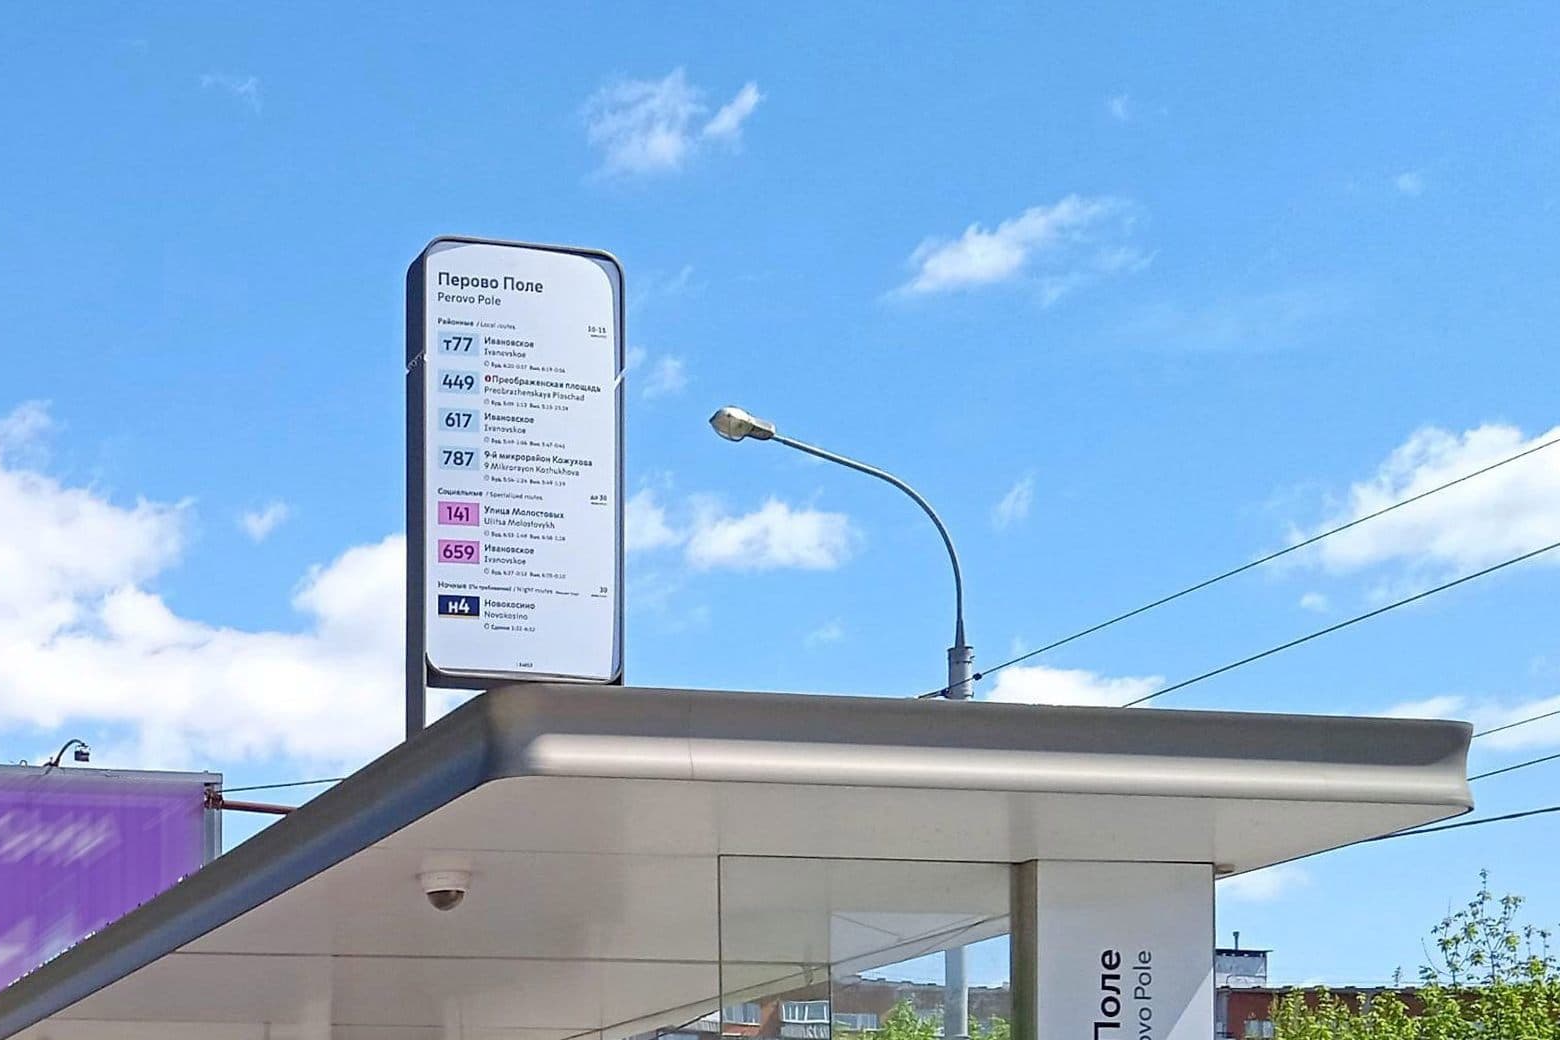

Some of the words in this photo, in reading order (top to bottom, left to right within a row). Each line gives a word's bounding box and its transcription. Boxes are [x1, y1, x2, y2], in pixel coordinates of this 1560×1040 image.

[438, 272, 499, 290] Перово
[503, 276, 544, 293] Поле
[438, 292, 475, 304] Perovo
[478, 294, 502, 306] Pole
[484, 336, 534, 348] Ивановское
[484, 348, 526, 358] Ivanovskoe
[442, 374, 474, 390] 449
[492, 375, 564, 389] Преображенская
[565, 382, 601, 393] площадь
[445, 412, 472, 428] 617
[484, 412, 535, 424] Ивановское
[484, 424, 526, 434] Ivanovskoe
[443, 450, 474, 467] 787
[499, 452, 551, 463] микрорайон
[552, 456, 593, 467] Кожухова
[447, 506, 470, 522] 141
[484, 505, 510, 515] Улица
[512, 507, 565, 518] Молостовых
[484, 518, 506, 526] Ulitsa
[443, 544, 475, 560] 659
[484, 544, 535, 554] Ивановское
[484, 556, 526, 565] Ivanovskoe
[484, 600, 536, 610] Новокосино
[1132, 950, 1152, 1000] Pole
